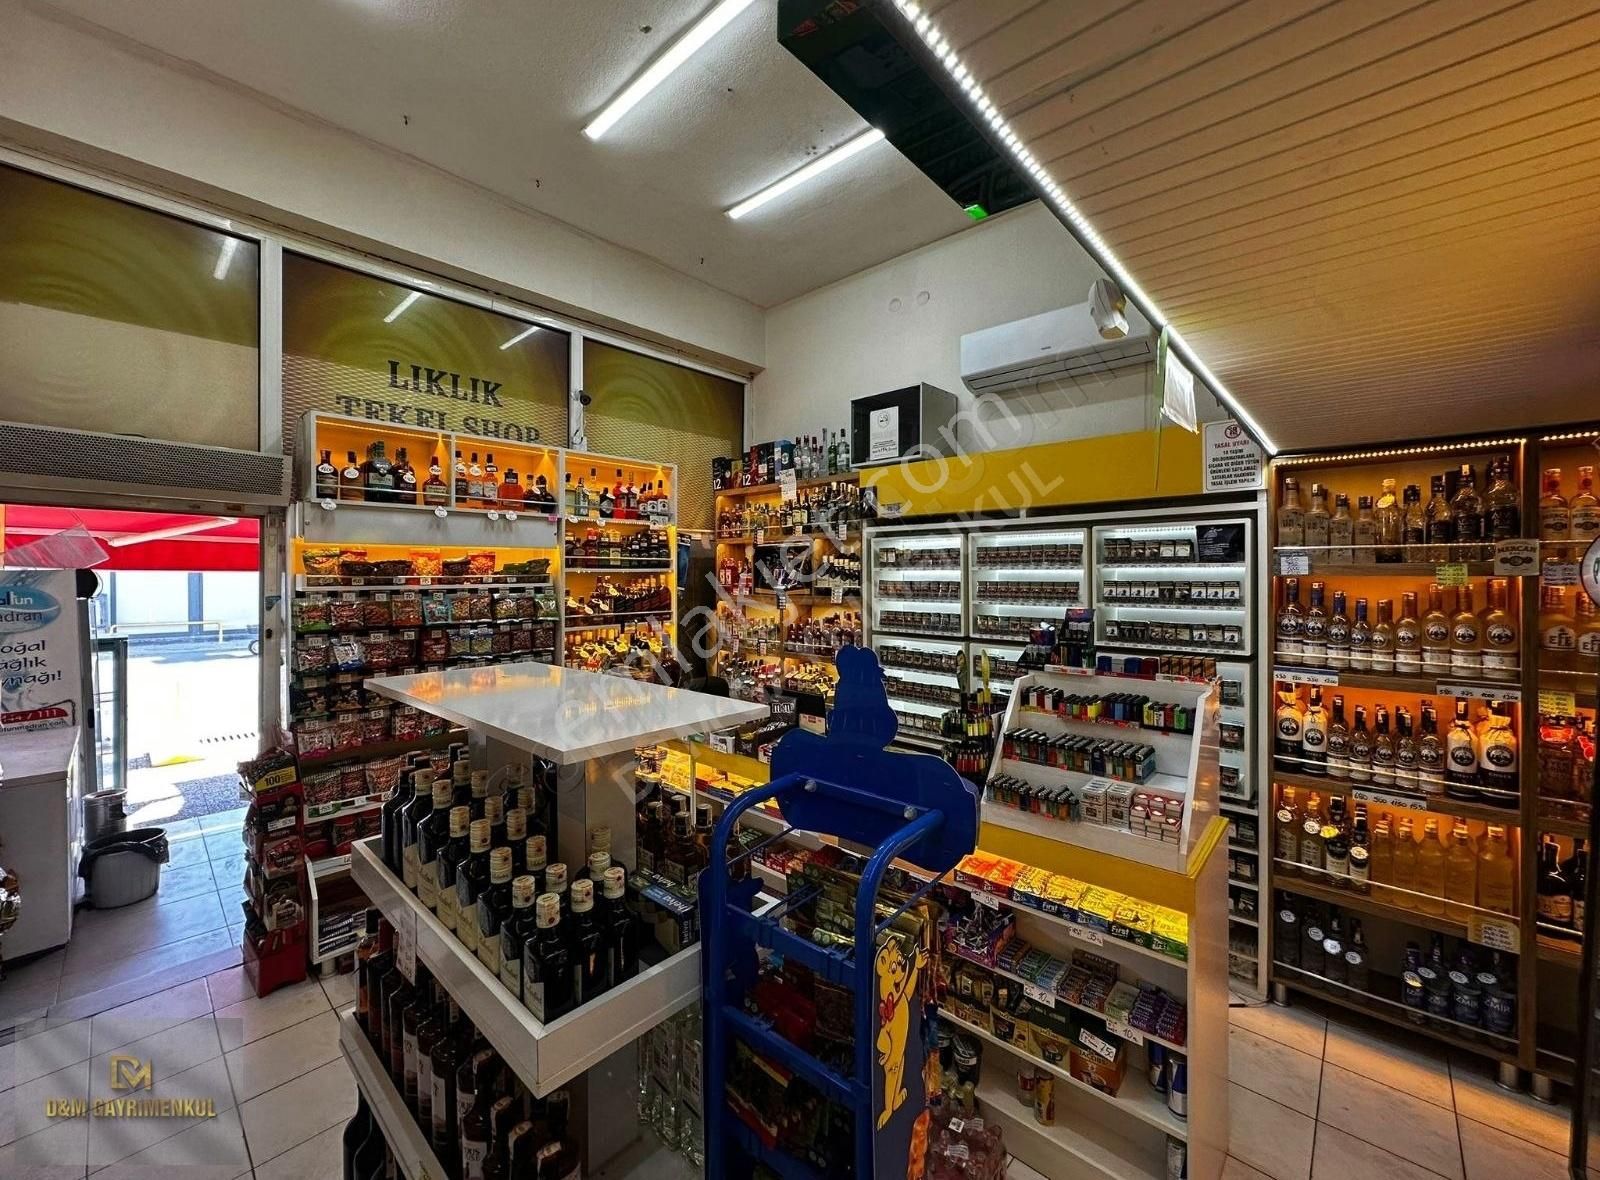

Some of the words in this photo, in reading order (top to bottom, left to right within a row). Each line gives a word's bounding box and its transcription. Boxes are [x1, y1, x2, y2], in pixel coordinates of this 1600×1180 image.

[388, 360, 503, 407] LIKLIK
[742, 474, 751, 486] 12
[0, 611, 42, 622] dran
[265, 775, 281, 786] 100
[1112, 926, 1130, 935] First
[1123, 1028, 1133, 1038] 10
